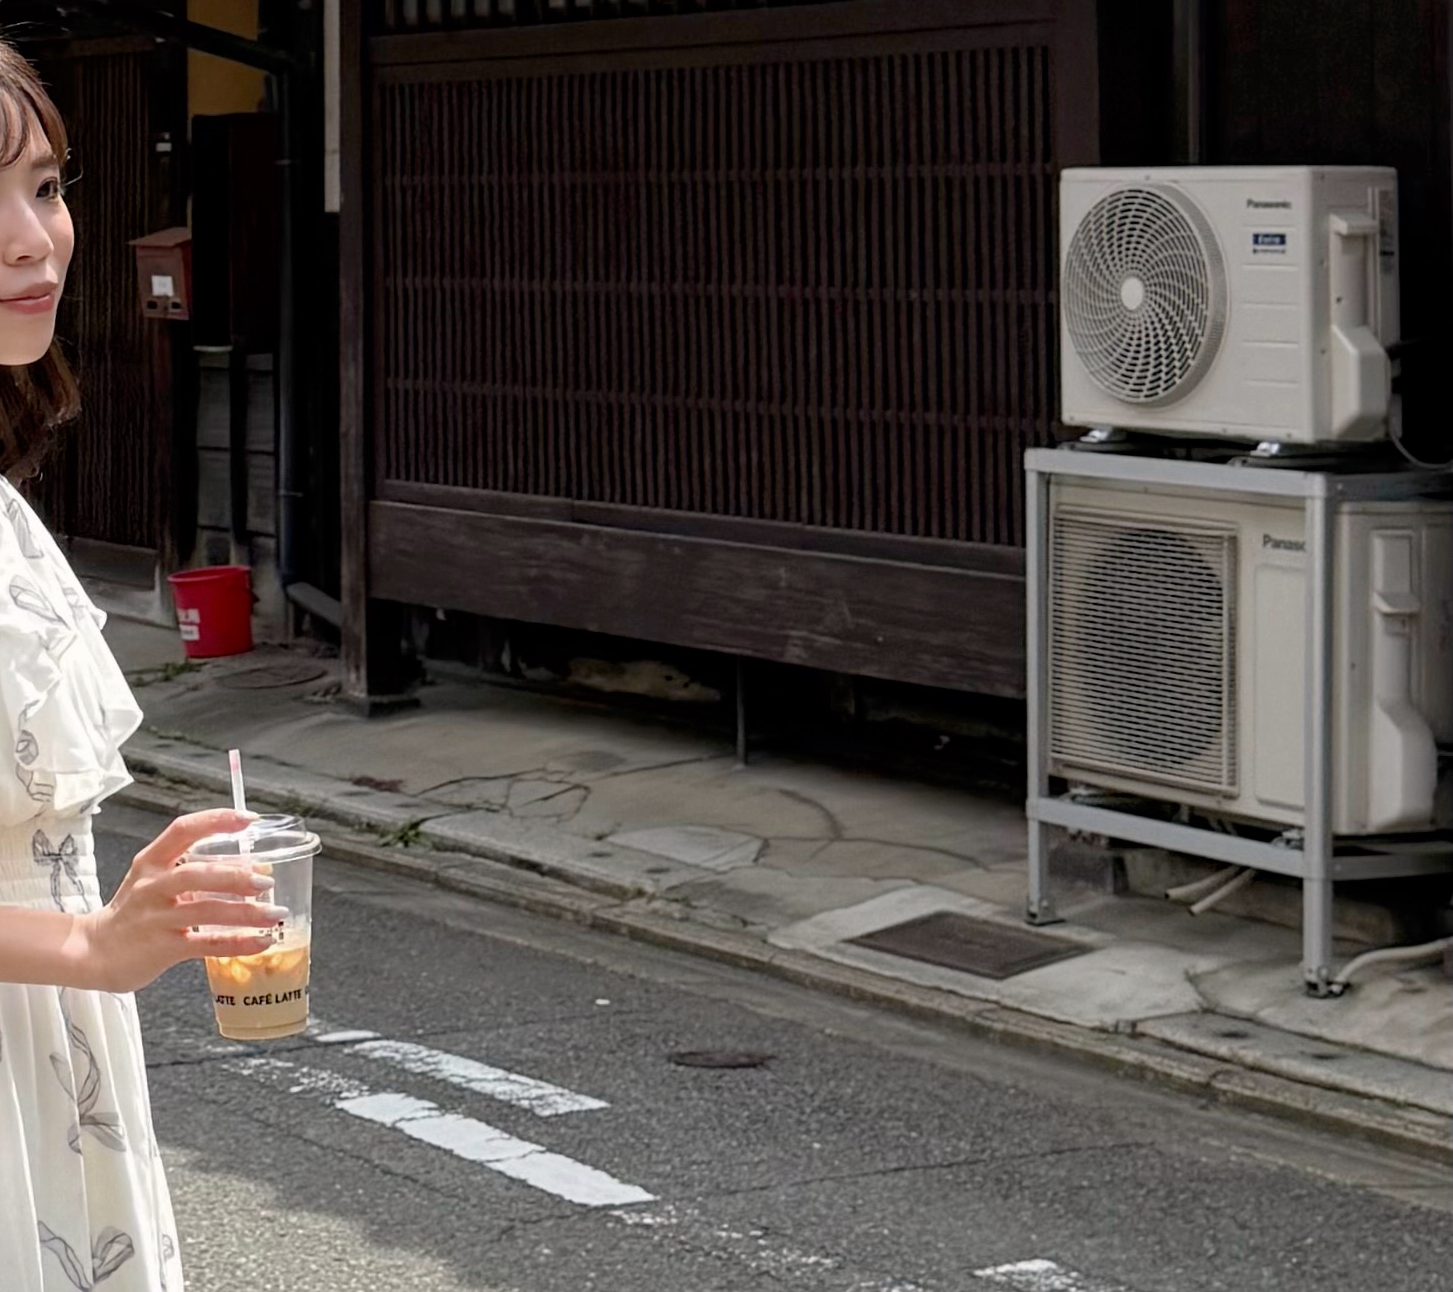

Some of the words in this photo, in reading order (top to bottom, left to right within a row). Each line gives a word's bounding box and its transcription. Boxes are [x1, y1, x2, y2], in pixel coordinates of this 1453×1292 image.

[1246, 198, 1292, 210] Panasonic
[243, 992, 272, 1006] CAFÉ
[275, 988, 302, 1004] LATTE
